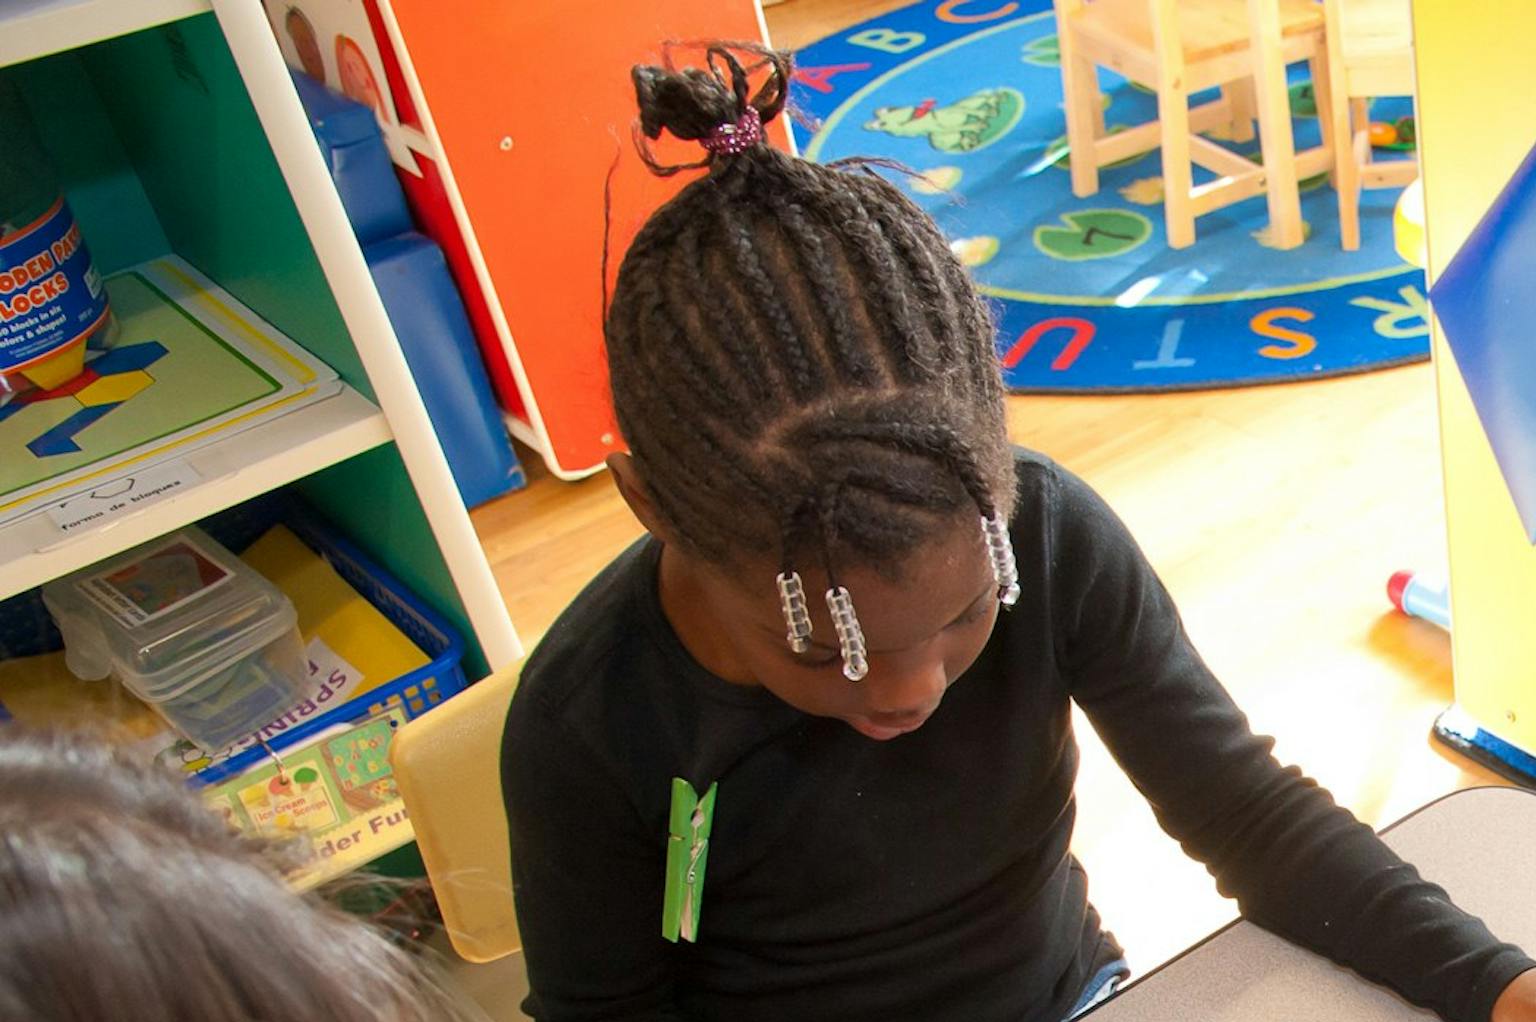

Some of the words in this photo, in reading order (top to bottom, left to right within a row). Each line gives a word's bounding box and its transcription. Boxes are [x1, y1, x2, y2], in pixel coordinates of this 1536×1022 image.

[793, 62, 870, 93] A
[847, 28, 926, 53] B
[1250, 307, 1316, 359] S
[1350, 286, 1431, 341] R
[1004, 317, 1096, 371] U
[1132, 318, 1197, 369] T
